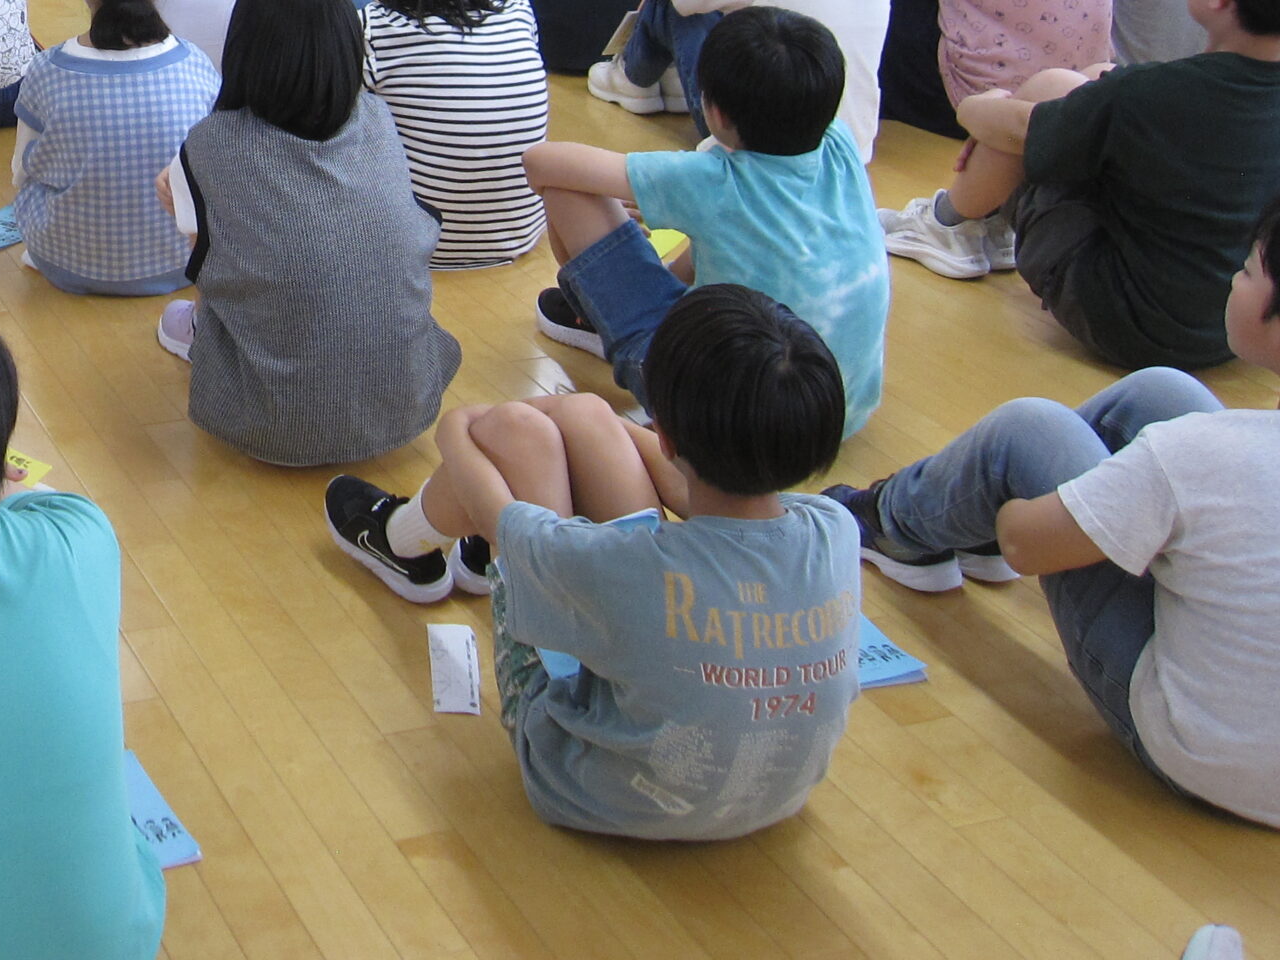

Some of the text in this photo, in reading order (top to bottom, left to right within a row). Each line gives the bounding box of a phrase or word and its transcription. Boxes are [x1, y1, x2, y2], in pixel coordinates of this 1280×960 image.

[700, 662, 791, 689] WORLD
[797, 649, 847, 685] TOUR
[750, 692, 817, 722] 1974
